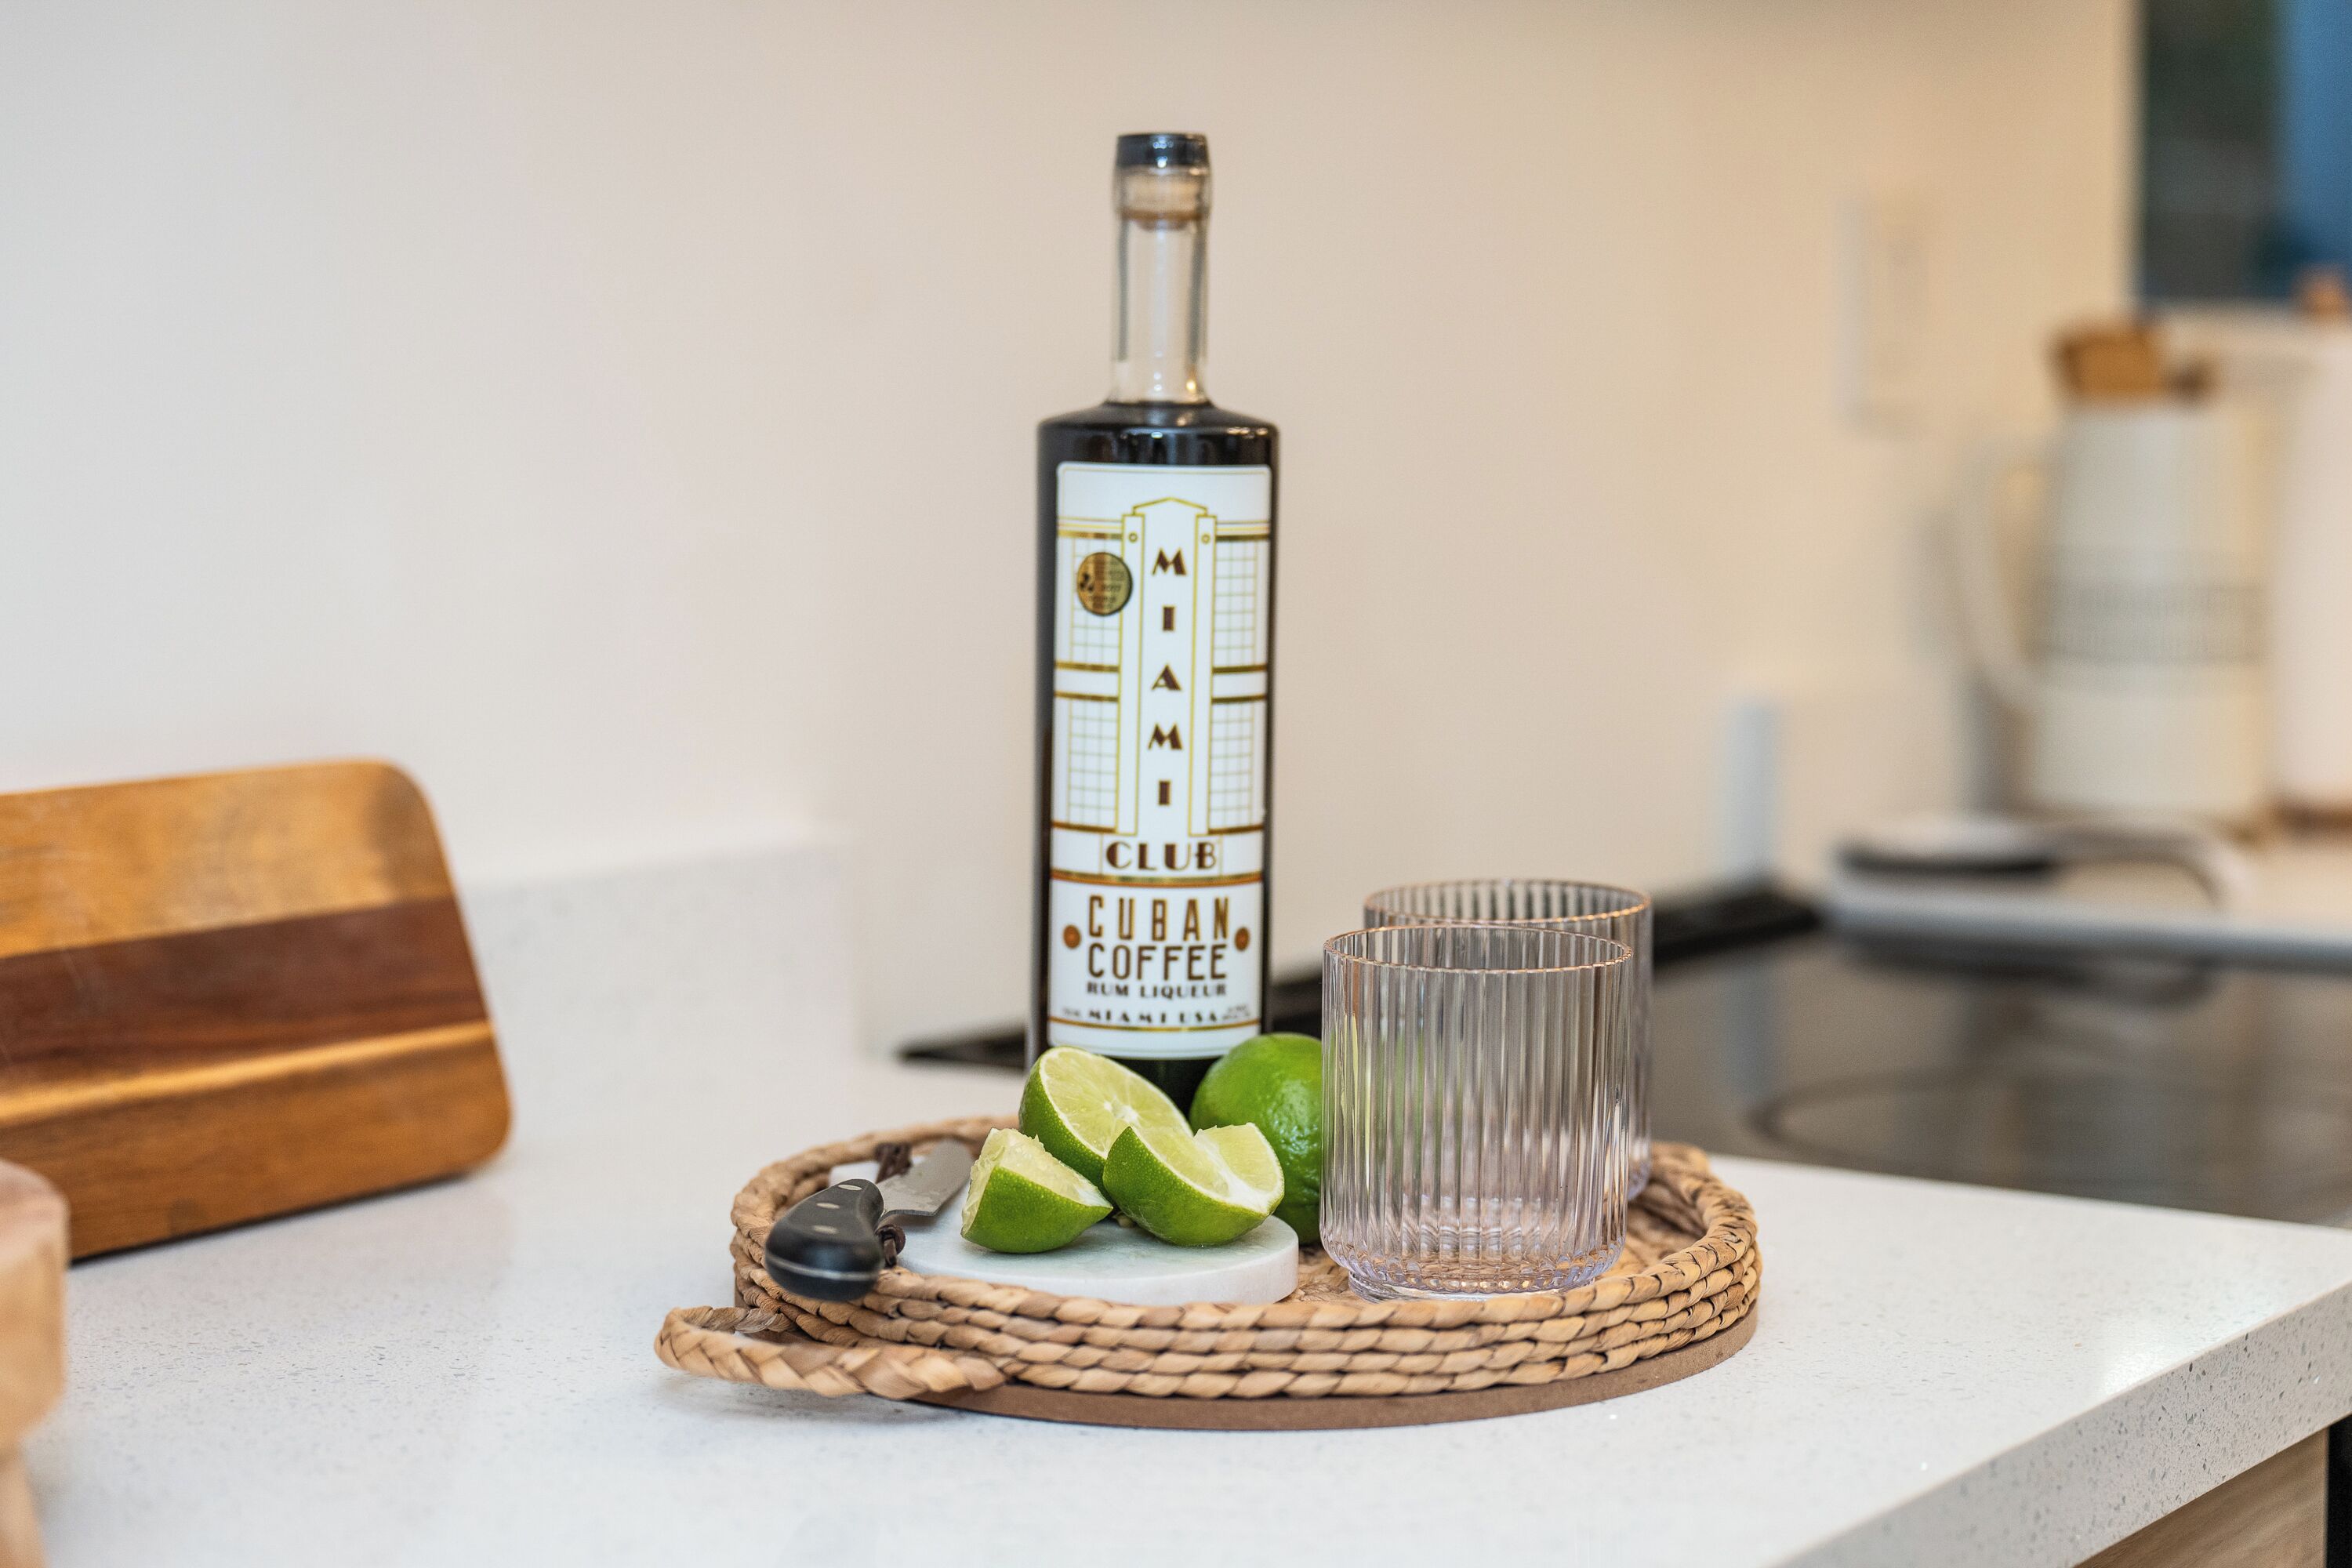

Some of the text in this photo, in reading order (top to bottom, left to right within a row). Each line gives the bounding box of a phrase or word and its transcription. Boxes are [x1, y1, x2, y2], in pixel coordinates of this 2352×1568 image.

[1149, 547, 1187, 806] MIAMI
[1106, 841, 1217, 870] CLUB
[1088, 894, 1229, 941] CUBAN
[1088, 942, 1227, 981] COFFEE
[1087, 982, 1226, 1000] RUM LIQUEUR
[1089, 1009, 1167, 1023] MIAMI
